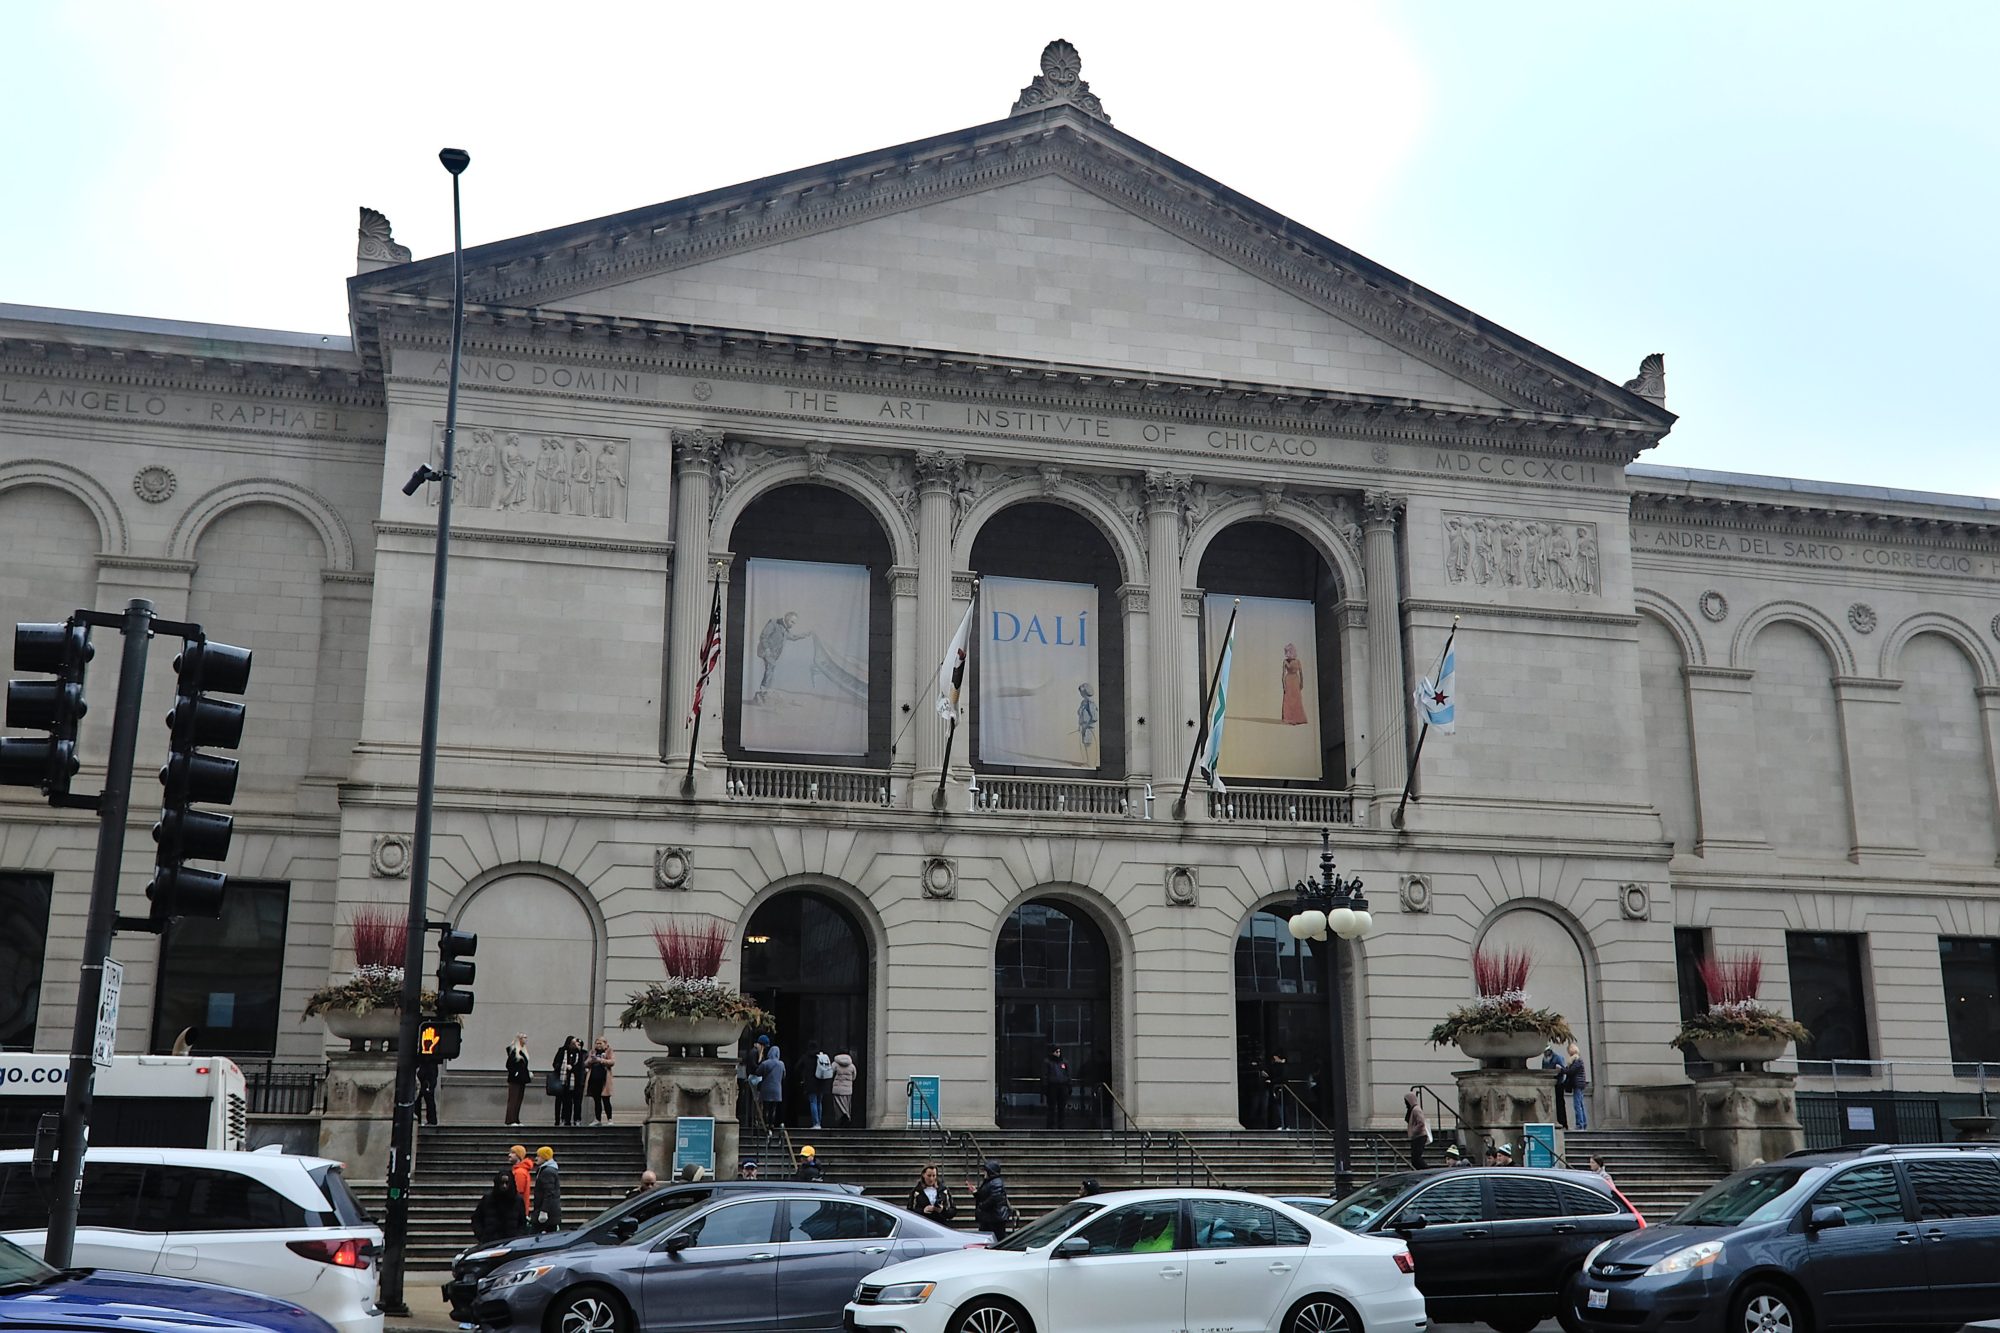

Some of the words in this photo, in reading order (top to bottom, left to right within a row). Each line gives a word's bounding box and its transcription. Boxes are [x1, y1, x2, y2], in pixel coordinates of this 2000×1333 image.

[433, 358, 516, 382] ANNO
[532, 366, 640, 394] DOMINI
[33, 387, 166, 416] ANGELO
[210, 402, 348, 432] RAPHAEL
[784, 390, 839, 413] THE
[878, 400, 931, 421] ART
[966, 407, 1111, 438] INSTITVTE
[1142, 424, 1177, 443] OF
[1207, 430, 1318, 457] CHICAGO
[1435, 452, 1595, 483] MDCCCXCII
[1655, 531, 1730, 551] ANDREA
[1739, 537, 1777, 556] DEL
[1783, 541, 1843, 562] SARTO
[1862, 548, 1971, 573] CORREGGIO
[992, 610, 1088, 647] DALÍ
[0, 1067, 69, 1086] o.co
